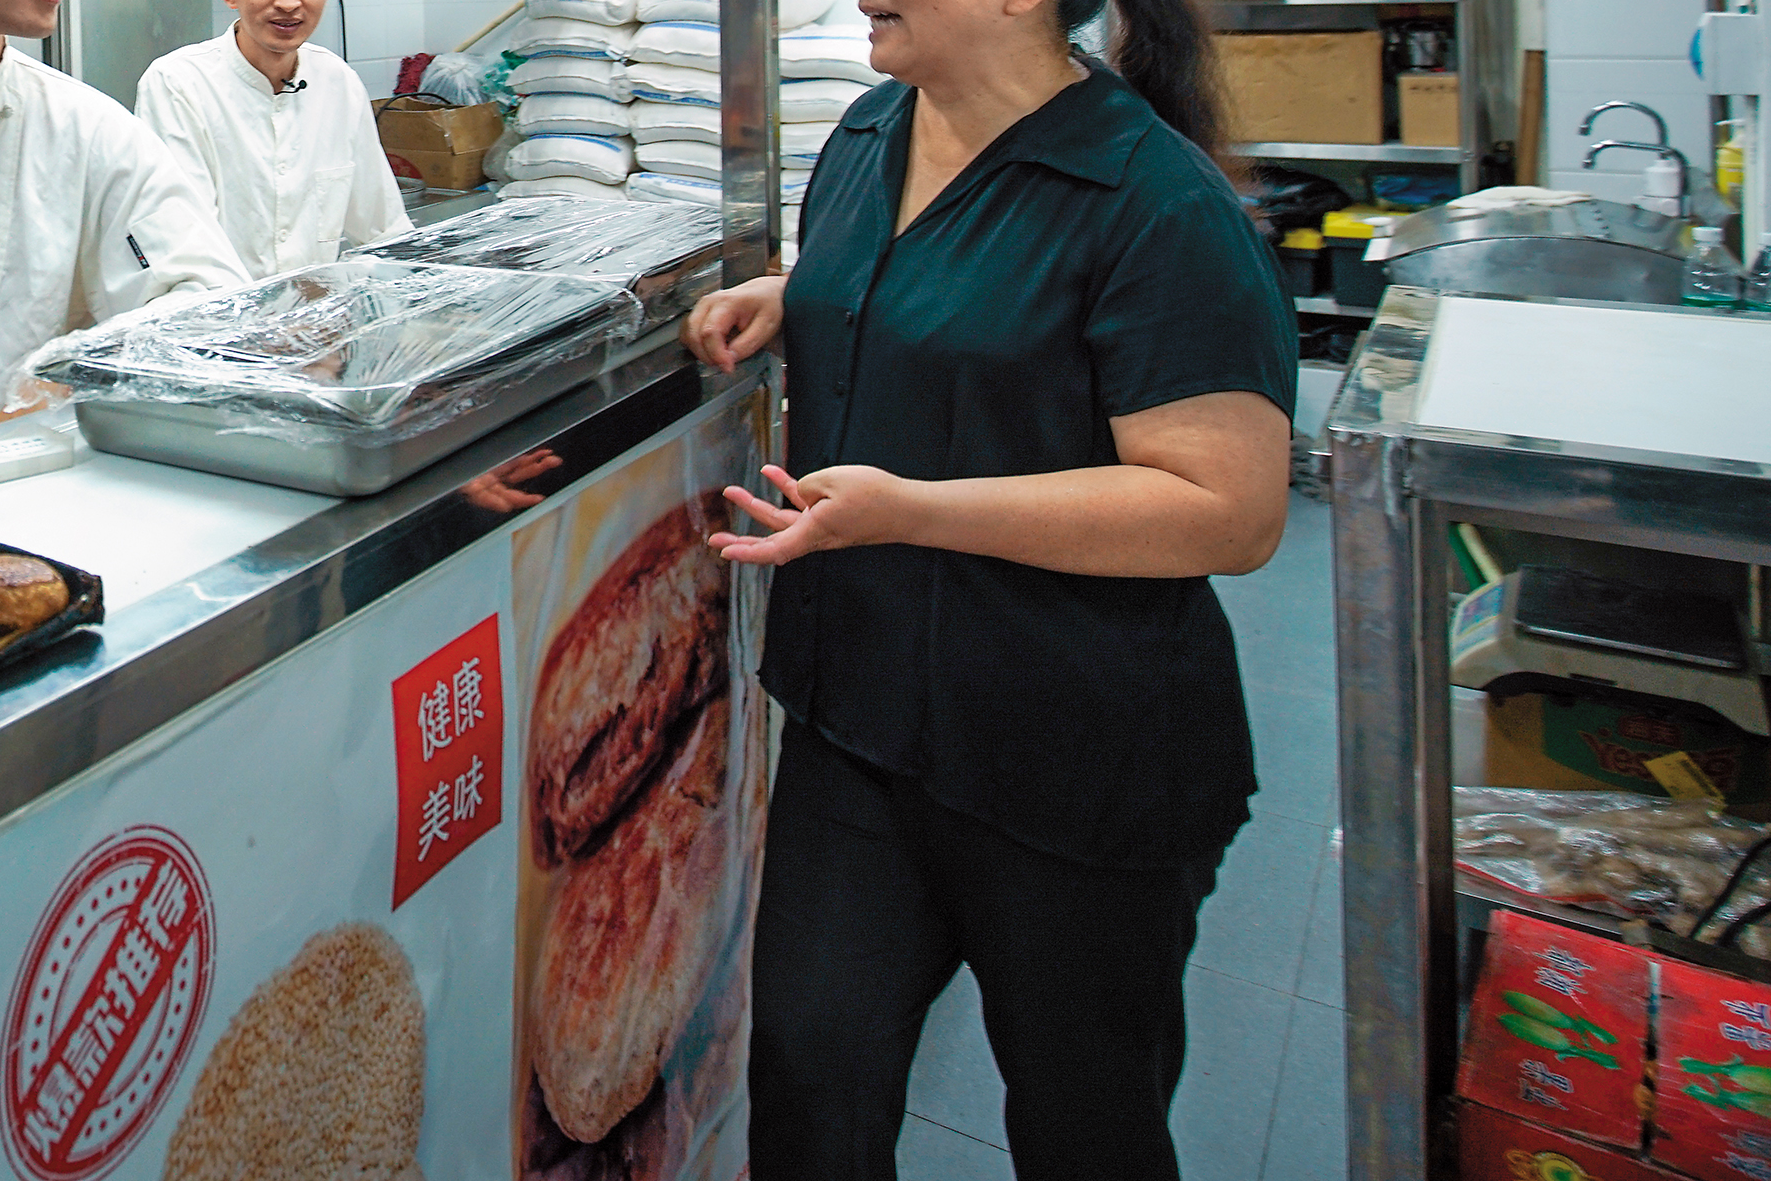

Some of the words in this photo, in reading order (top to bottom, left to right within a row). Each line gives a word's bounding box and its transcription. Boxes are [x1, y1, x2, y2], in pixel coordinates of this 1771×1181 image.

[418, 657, 484, 762] 健康
[418, 754, 484, 862] 美味
[23, 857, 189, 1164] 爆款推荐
